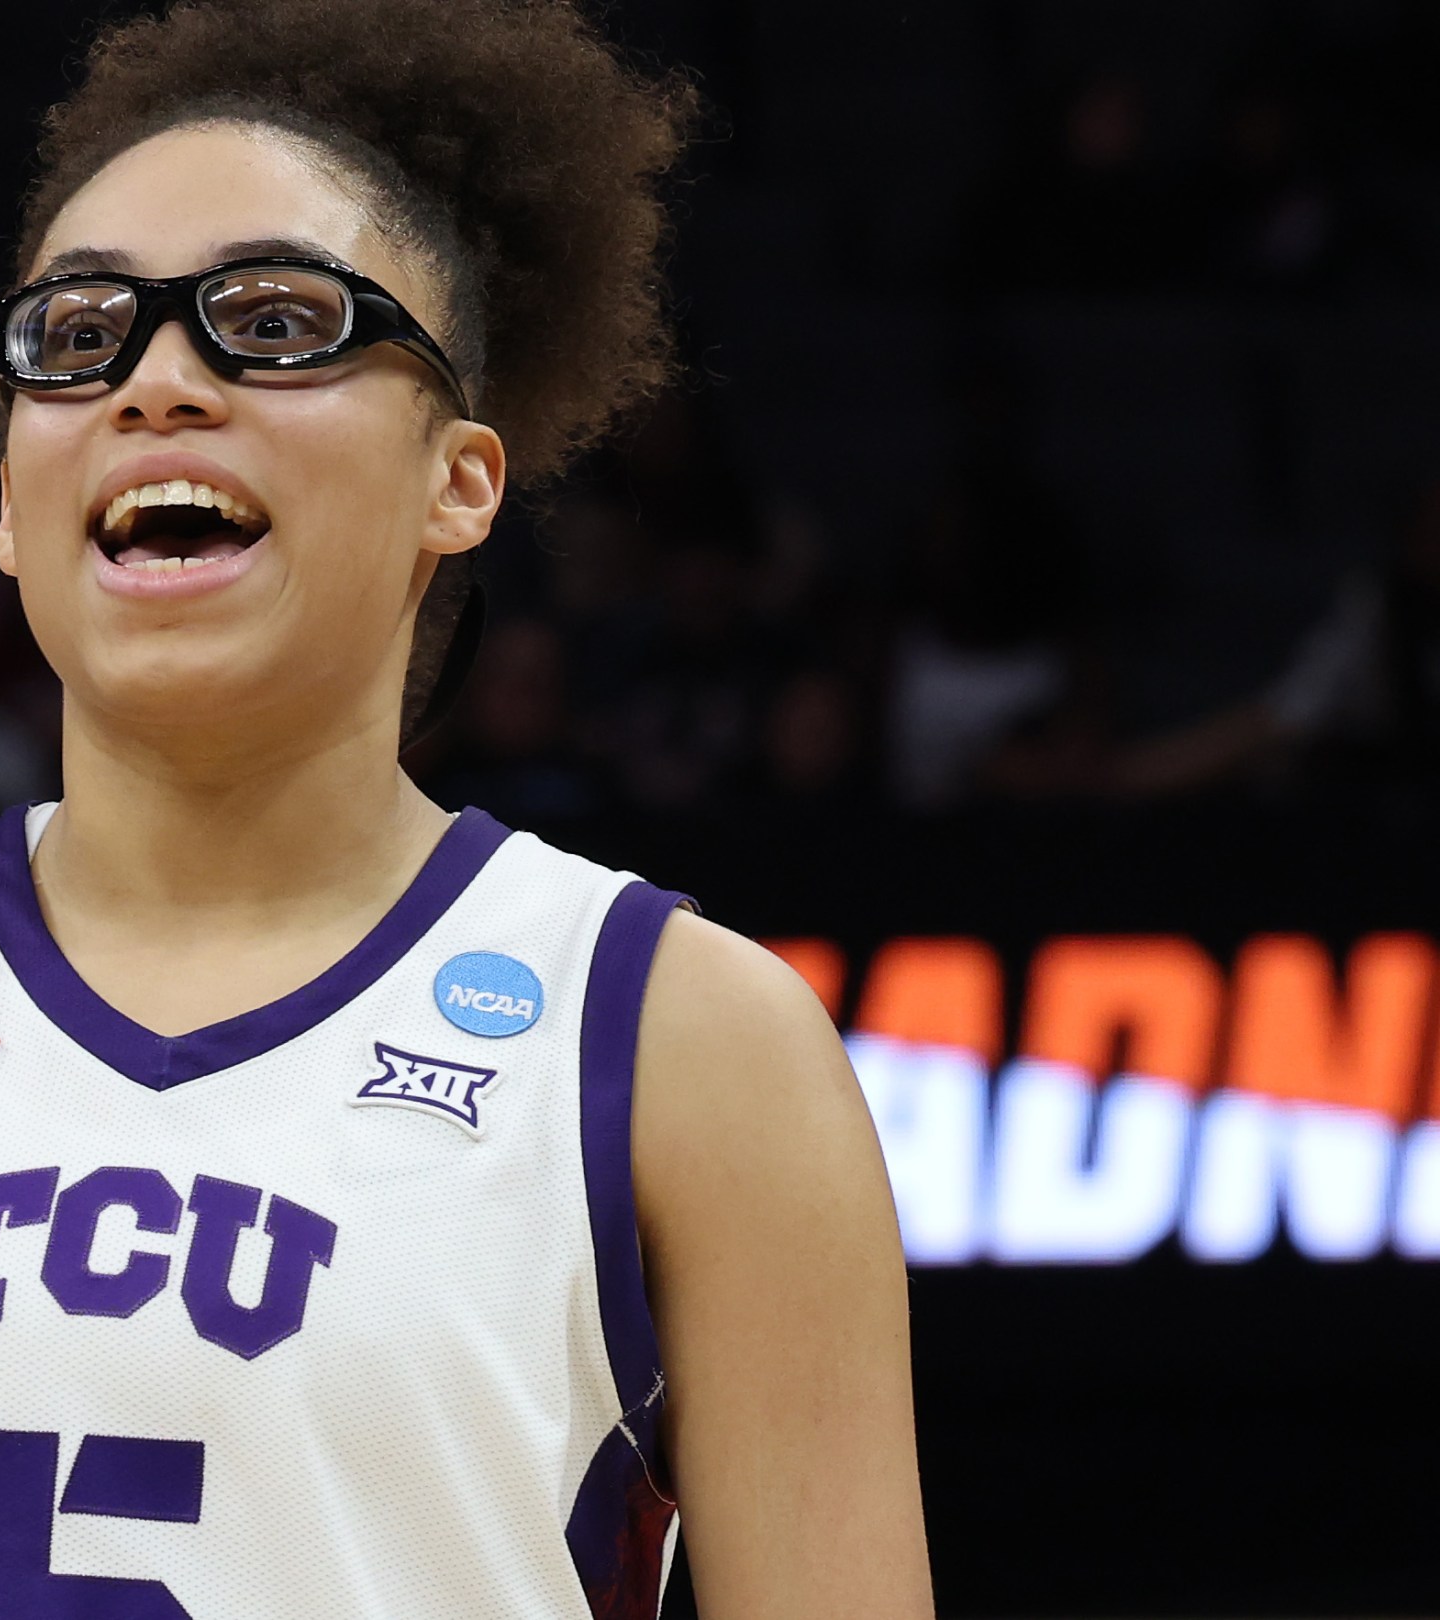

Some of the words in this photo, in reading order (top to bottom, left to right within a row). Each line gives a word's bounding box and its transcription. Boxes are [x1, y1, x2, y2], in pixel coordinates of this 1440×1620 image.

[445, 984, 536, 1021] NCAA
[363, 1047, 491, 1122] XII
[758, 934, 1440, 1266] ADN
